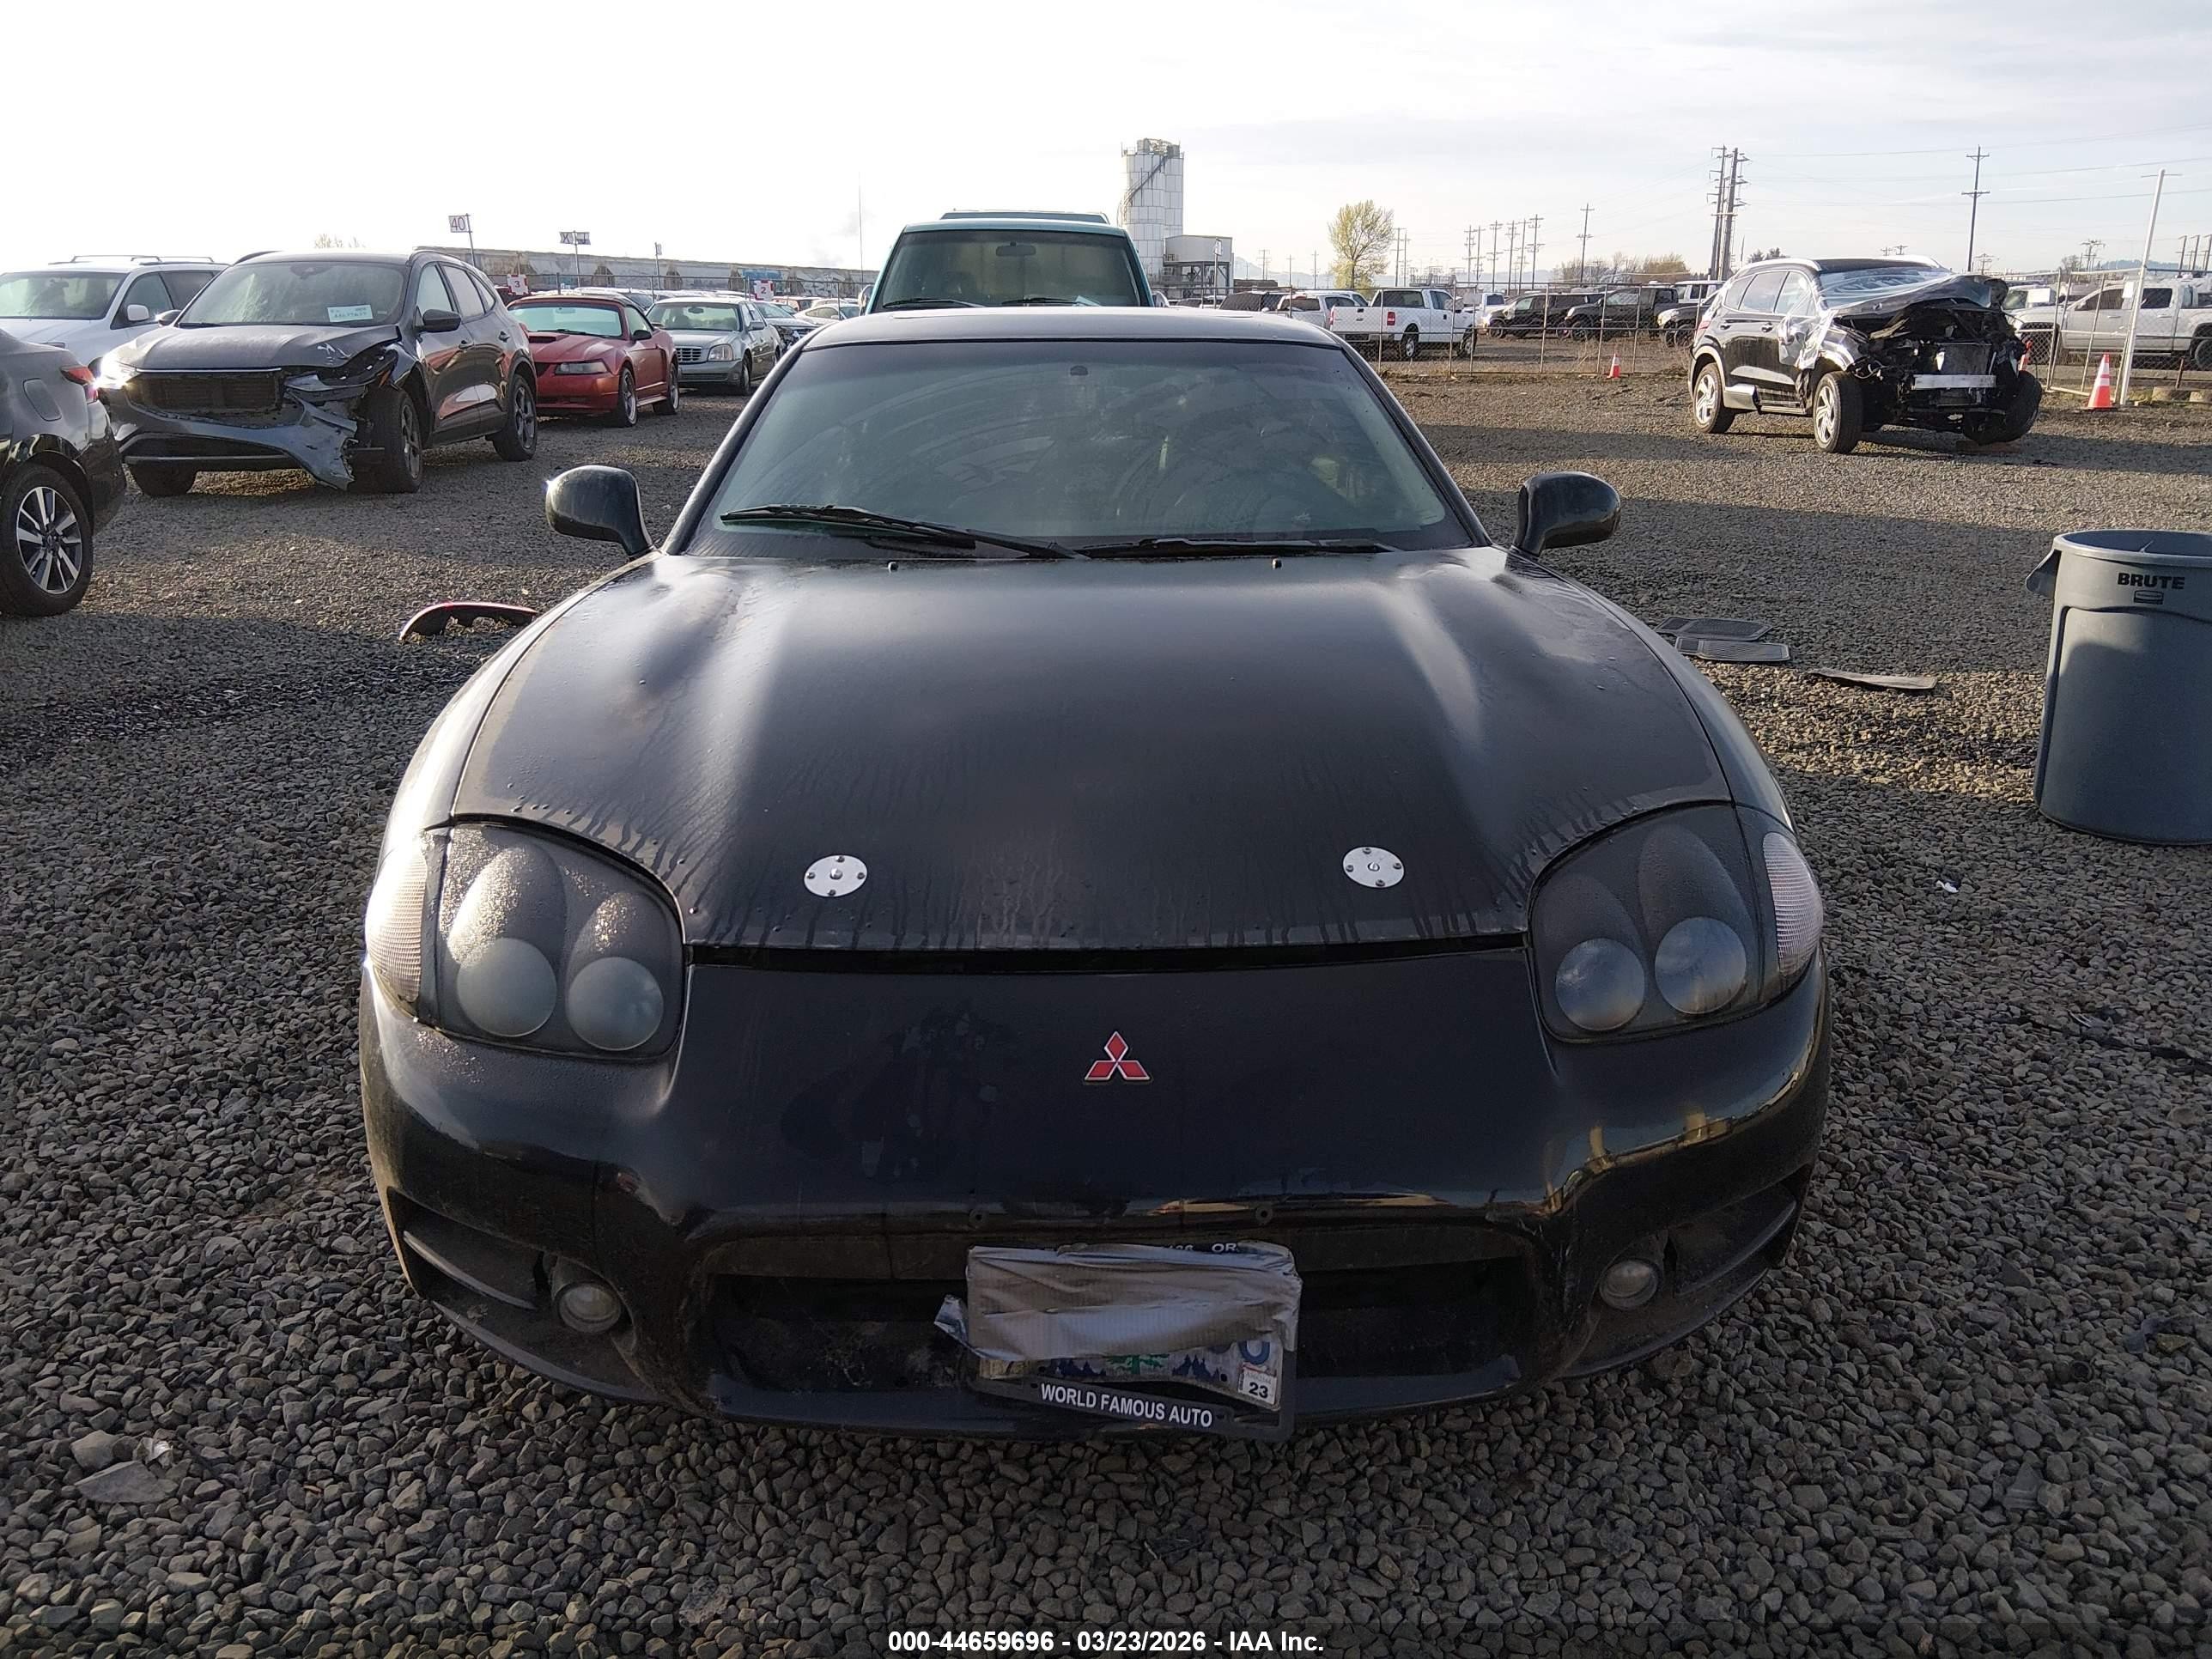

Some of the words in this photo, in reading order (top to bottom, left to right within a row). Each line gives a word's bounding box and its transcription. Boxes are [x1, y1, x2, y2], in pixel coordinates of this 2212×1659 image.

[451, 216, 465, 231] 40
[514, 280, 520, 289] 3
[761, 286, 767, 295] 2
[2118, 572, 2185, 590] BRUTE
[1249, 1382, 1268, 1399] 23
[1041, 1382, 1097, 1407] WORLD
[1100, 1394, 1165, 1420] FAMOUS
[1168, 1406, 1212, 1427] AUTO
